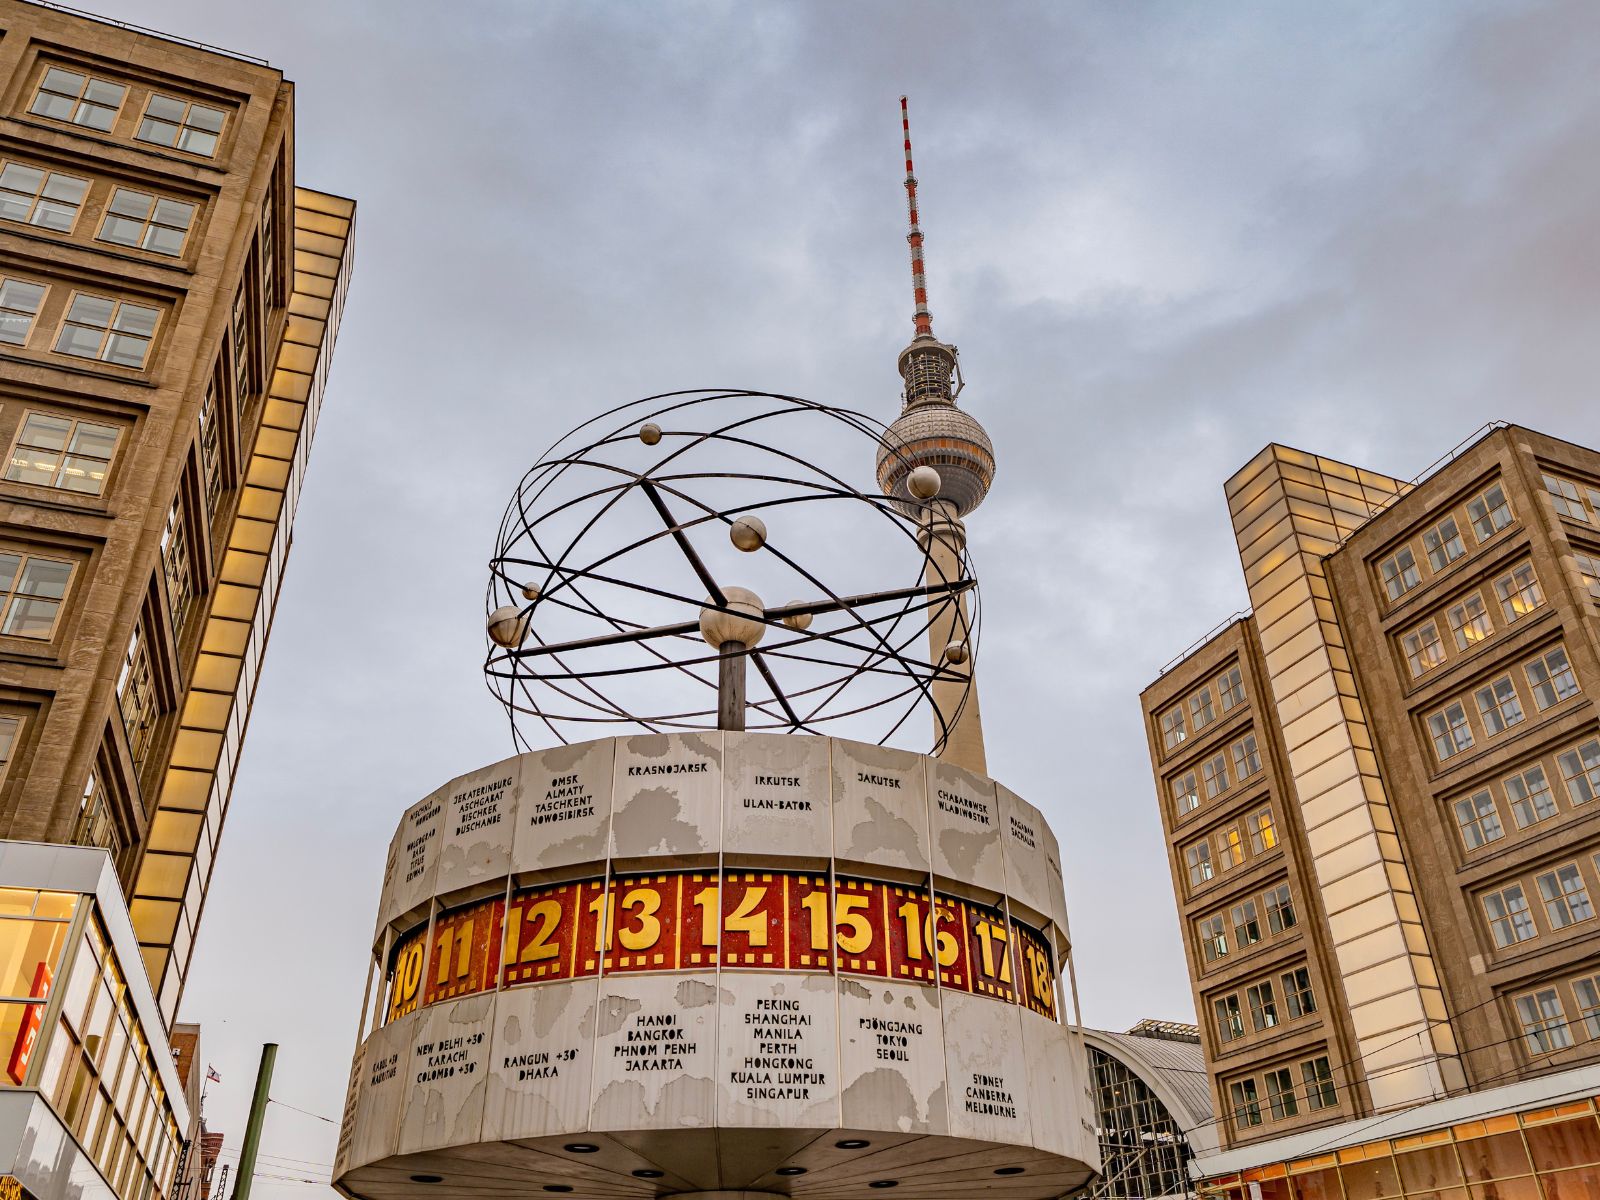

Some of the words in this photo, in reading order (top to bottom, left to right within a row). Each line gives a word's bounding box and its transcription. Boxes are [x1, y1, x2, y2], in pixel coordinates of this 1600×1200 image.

[628, 763, 708, 776] KRASNOJARSK
[552, 775, 579, 787] OMSK
[755, 776, 801, 787] IRKUTSK
[857, 772, 901, 789] JAKUTSK
[453, 777, 513, 805] JEKATERINBURG
[545, 785, 584, 800] ALMATY
[459, 791, 504, 814] ASCHGABAT
[535, 795, 592, 813] TASCHKENT
[743, 799, 812, 811] ULAN-BATOR
[938, 790, 988, 814] CHABAROWSK
[462, 804, 498, 823] BISCHKEK
[530, 807, 594, 826] NOWOSIBIRSK
[938, 800, 990, 826] WLADIWOSTOK
[456, 814, 502, 836] DUSCHANBE
[589, 888, 661, 952] 13
[693, 886, 768, 947] 14
[801, 891, 874, 954] 15
[499, 899, 562, 966] 12
[898, 902, 960, 967] 16
[437, 919, 475, 985] 11
[975, 920, 1015, 984] 17
[394, 943, 423, 1007] 10
[1026, 944, 1052, 1009] 18
[756, 999, 800, 1011] PEKING
[637, 1015, 677, 1027] HANOI
[744, 1013, 812, 1026] SHANGHAI
[859, 1017, 923, 1035] PJÖNGJANG
[627, 1029, 684, 1042] BANGKOK
[753, 1028, 803, 1040] MANILA
[877, 1034, 908, 1047] TOKYO
[416, 1043, 434, 1057] NEW
[438, 1037, 463, 1052] DELHI
[614, 1045, 657, 1058] PHNOM
[664, 1043, 697, 1055] PENH
[759, 1043, 797, 1055] PERTH
[876, 1048, 909, 1062] SEOUL
[428, 1050, 468, 1068] KARACHI
[503, 1052, 549, 1069] RANGUN
[625, 1058, 683, 1072] JAKARTA
[744, 1057, 813, 1069] HONGKONG
[417, 1066, 454, 1084] COLOMBO
[518, 1066, 559, 1081] DHAKA
[730, 1072, 772, 1084] KUALA
[778, 1073, 825, 1085] LUMPUR
[973, 1073, 1004, 1089] SYDNEY
[746, 1087, 810, 1100] SINGAPUR
[966, 1087, 1014, 1104] CANBERRA
[966, 1101, 1017, 1118] MELBOURNE
